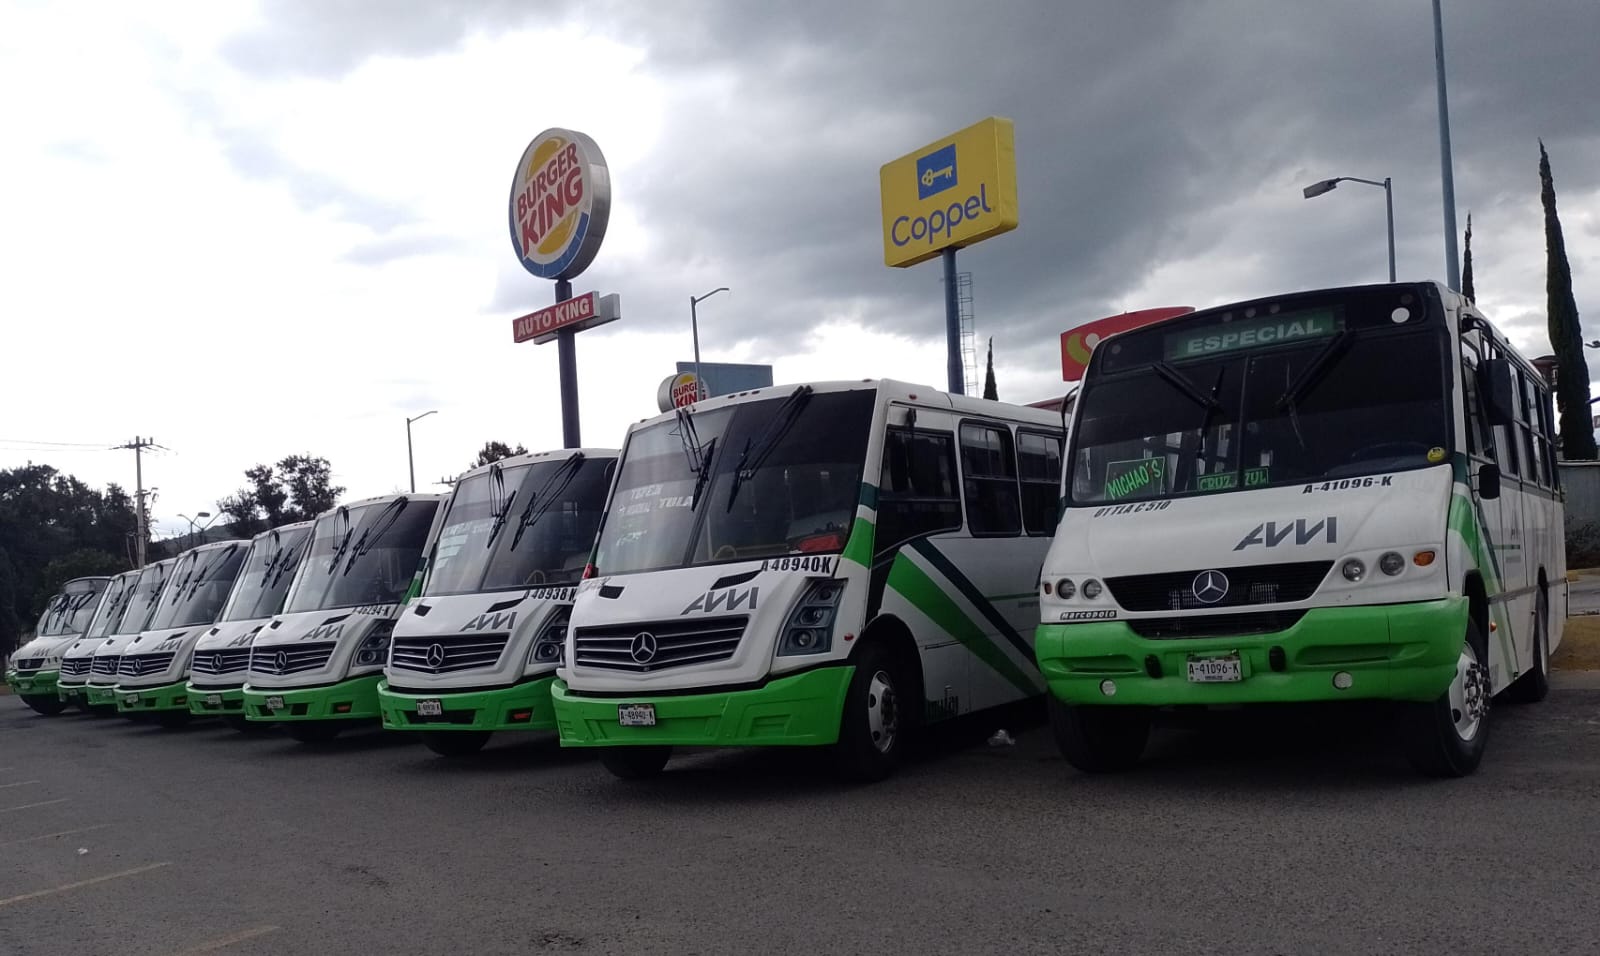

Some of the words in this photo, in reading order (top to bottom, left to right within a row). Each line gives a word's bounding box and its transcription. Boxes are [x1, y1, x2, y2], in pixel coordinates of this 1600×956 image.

[517, 142, 579, 220] BURGER
[522, 166, 584, 257] KING
[891, 183, 992, 247] Coppel
[518, 311, 551, 337] AUTO
[555, 298, 590, 324] KING
[1187, 319, 1323, 353] ESPECIAL
[673, 381, 705, 398] BURG
[1200, 475, 1232, 491] CRUZ
[1234, 471, 1267, 487] ZUL
[1302, 475, 1393, 494] A-41096-K
[1189, 663, 1239, 675] A-41096-K
